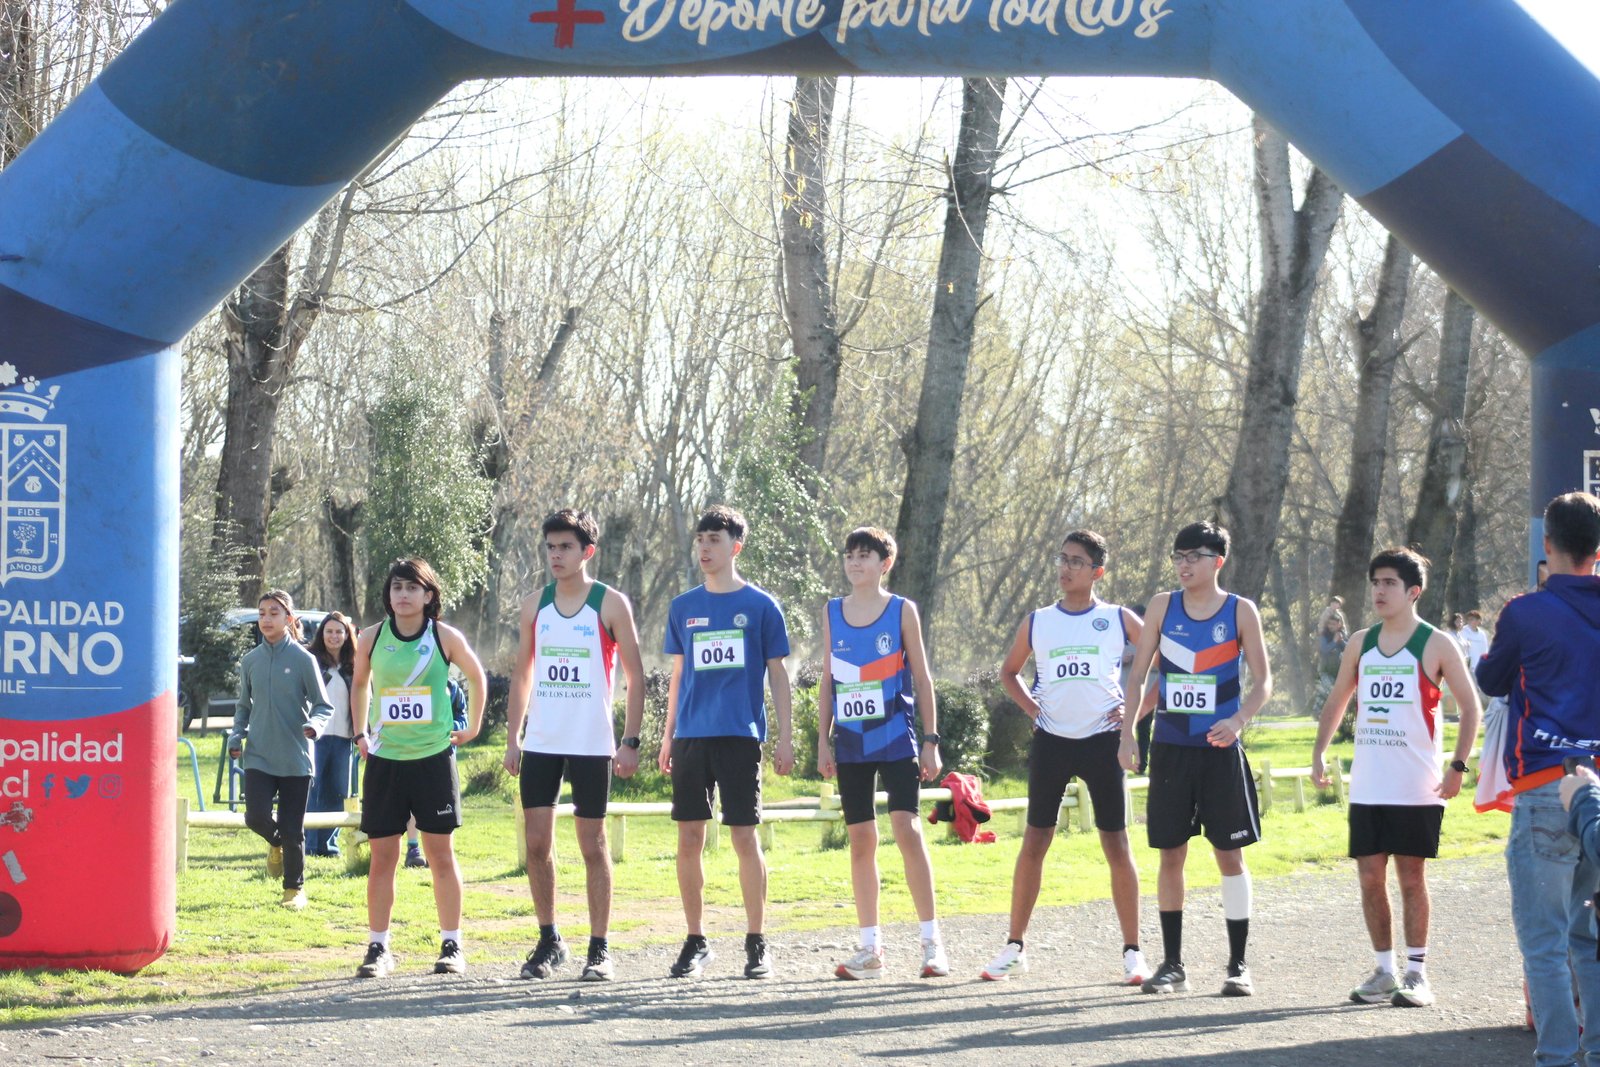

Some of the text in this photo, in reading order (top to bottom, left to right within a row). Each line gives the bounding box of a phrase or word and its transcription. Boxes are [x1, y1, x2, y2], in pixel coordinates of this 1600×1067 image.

[17, 508, 41, 517] FIDE
[50, 533, 58, 545] ET
[9, 563, 44, 573] AMORE
[701, 646, 735, 664] 004
[548, 665, 581, 682] 001
[1056, 661, 1091, 678] 003
[536, 689, 592, 698] DE LOS LAGOS
[1370, 682, 1404, 698] 002
[1173, 691, 1206, 708] 005
[389, 703, 423, 720] 050
[843, 699, 876, 717] 006
[1378, 739, 1408, 748] LAGOS
